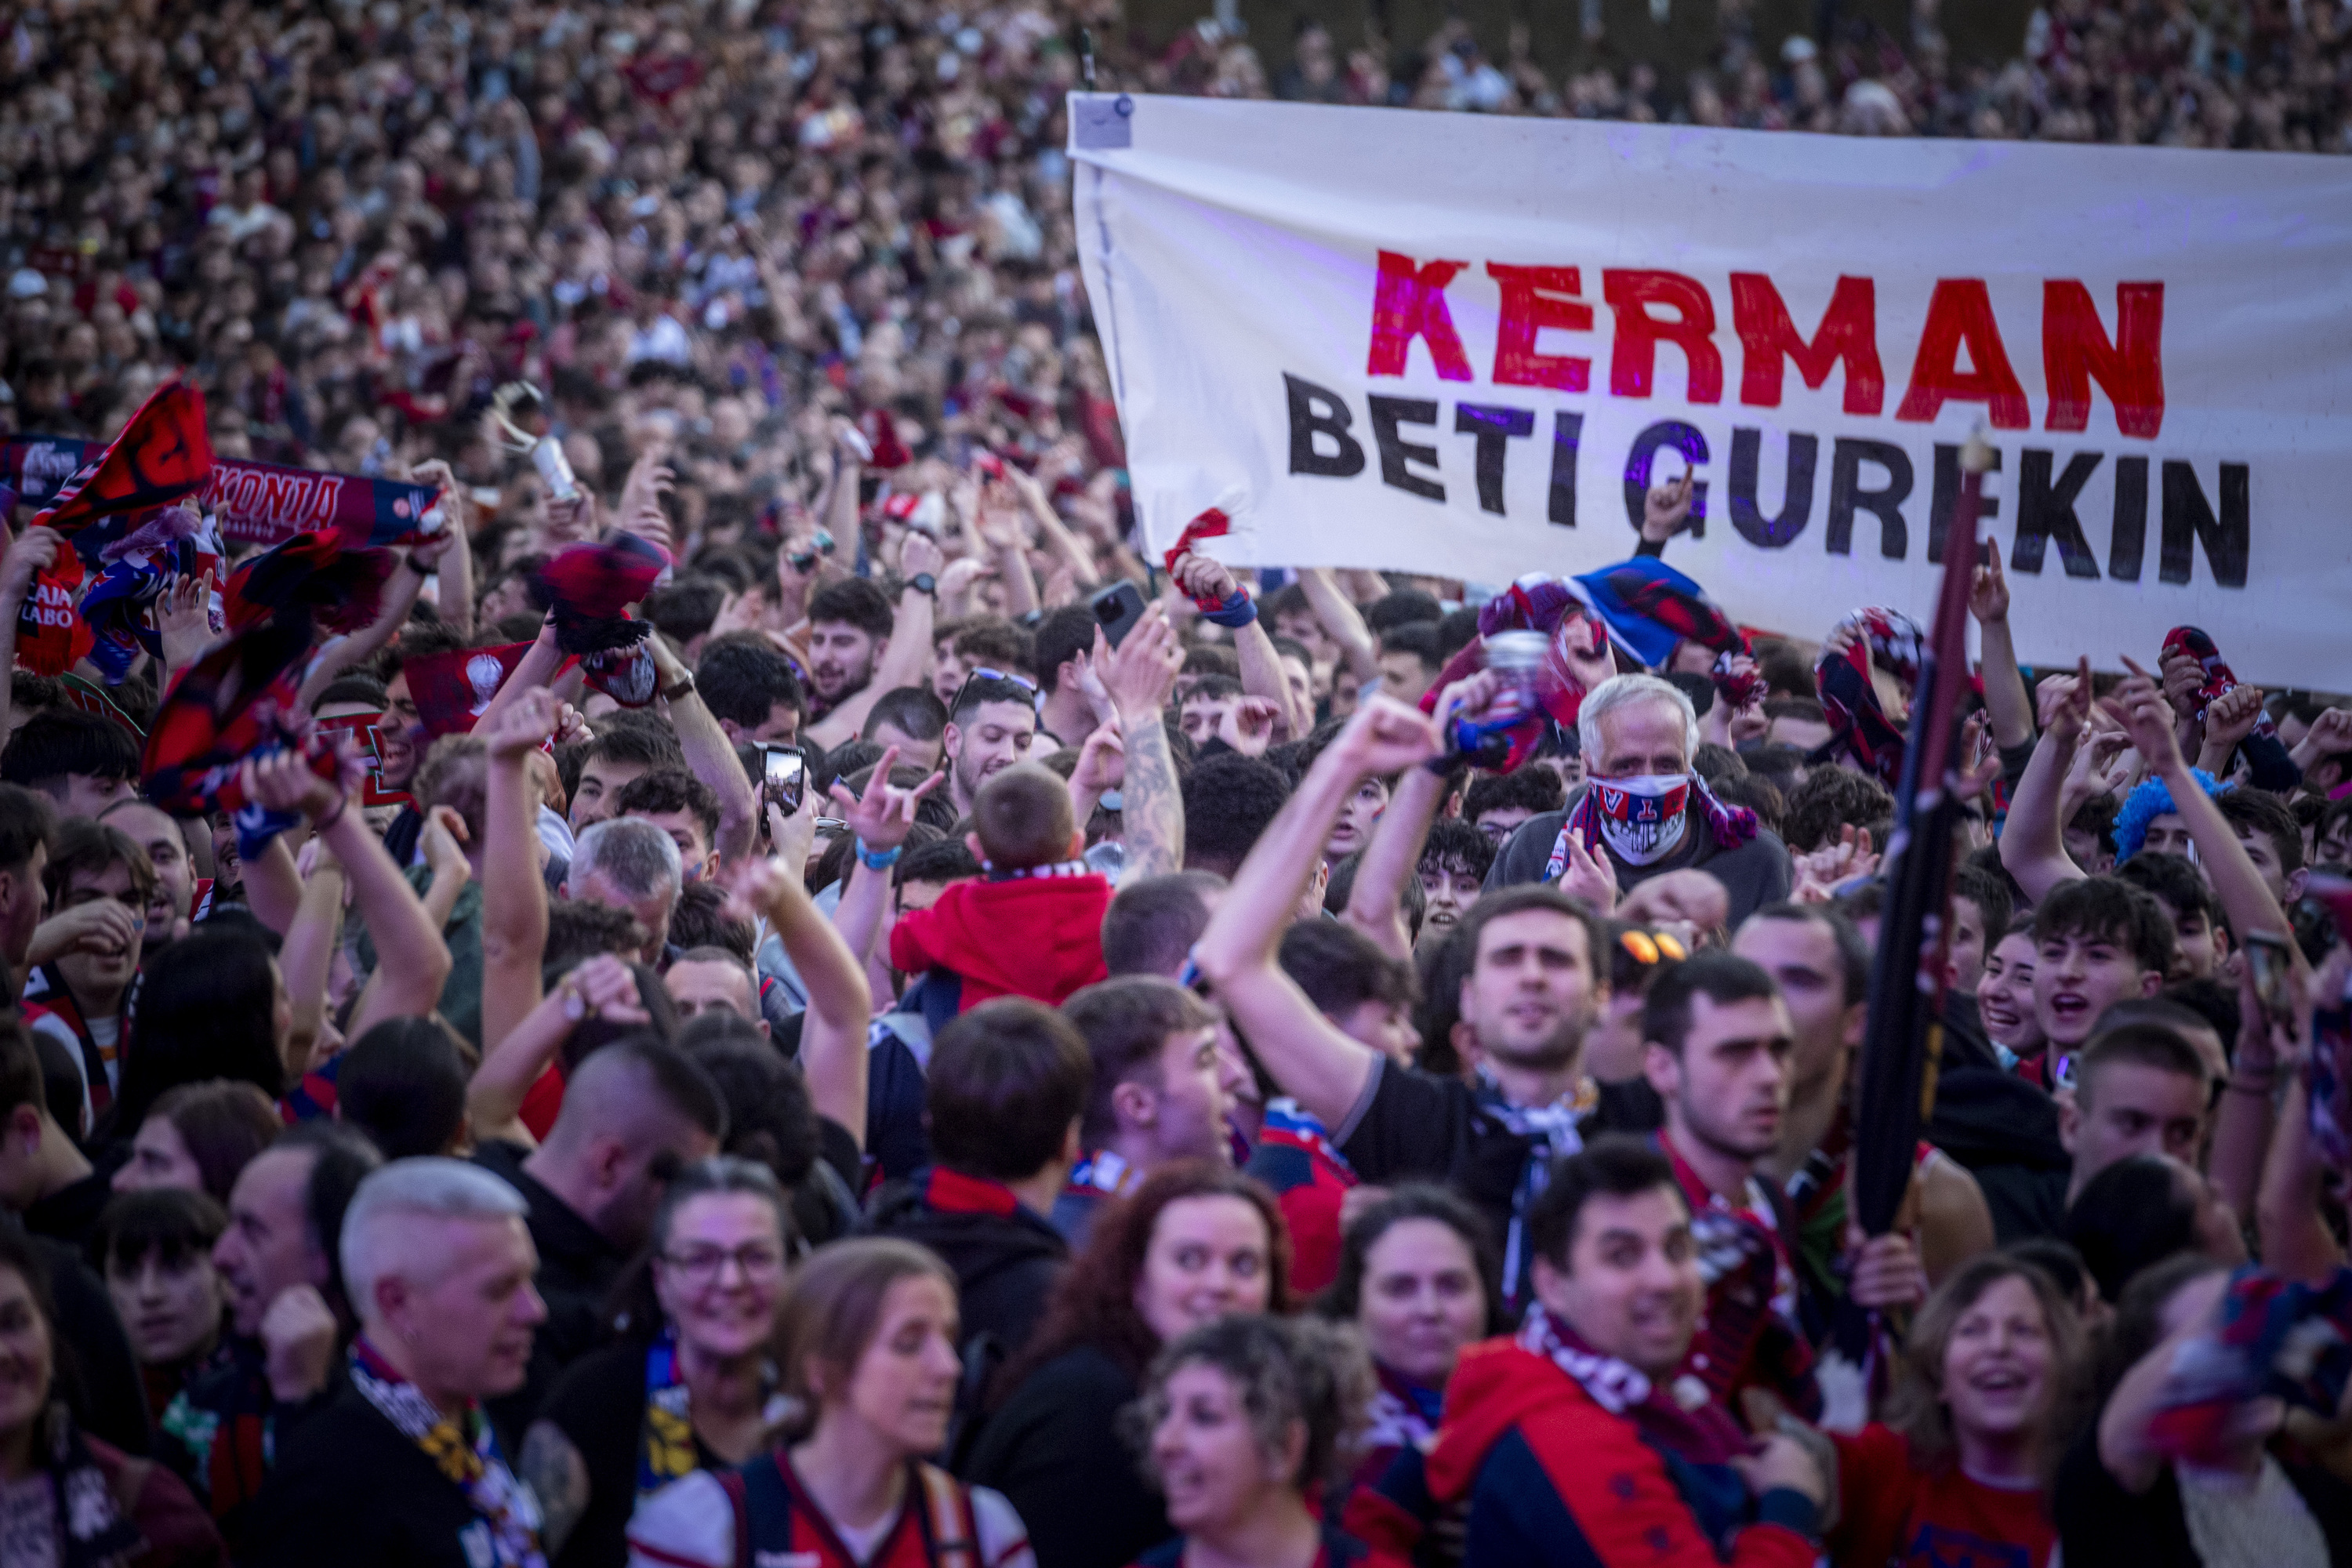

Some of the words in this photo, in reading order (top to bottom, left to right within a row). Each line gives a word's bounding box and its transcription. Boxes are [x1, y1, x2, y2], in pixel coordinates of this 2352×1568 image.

[1367, 249, 2165, 441] KERMAN
[1283, 371, 1582, 528] BETI
[1622, 419, 2251, 590] GUREKIN
